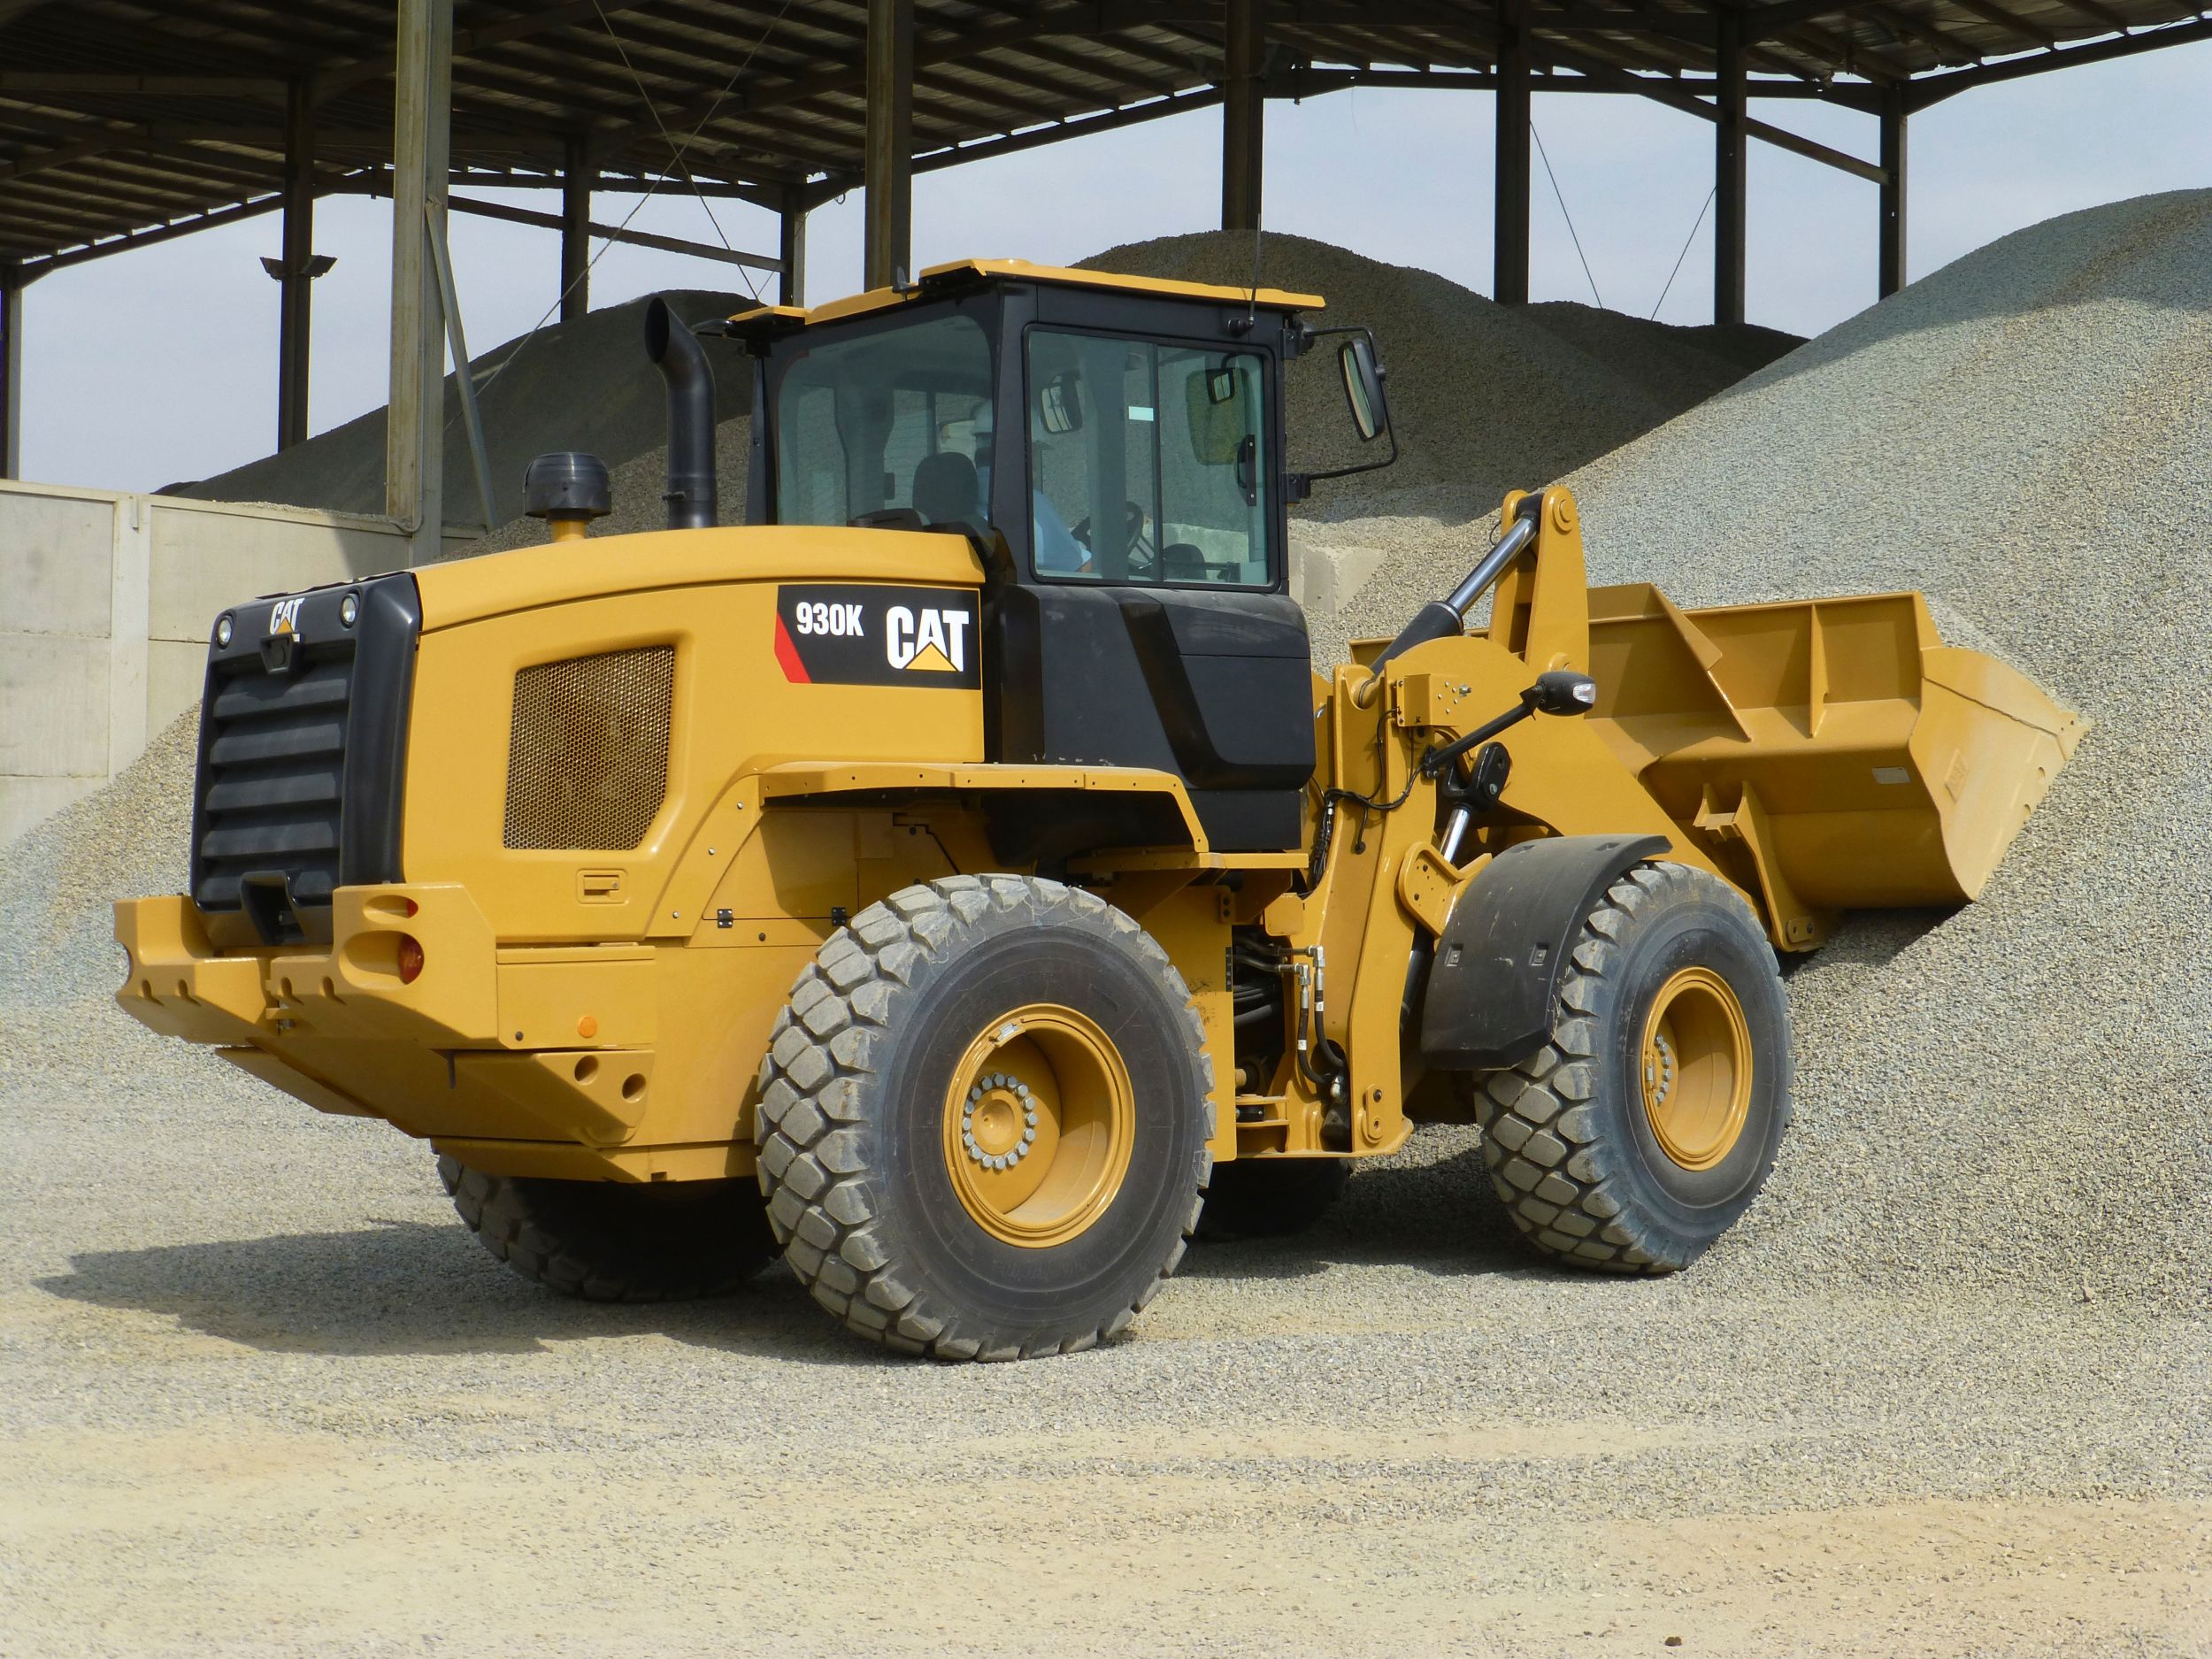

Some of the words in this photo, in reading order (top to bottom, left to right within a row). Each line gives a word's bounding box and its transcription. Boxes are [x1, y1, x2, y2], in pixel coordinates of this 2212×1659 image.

[269, 597, 305, 636] CAT
[795, 602, 864, 637] 930K
[886, 606, 970, 672] CAT
